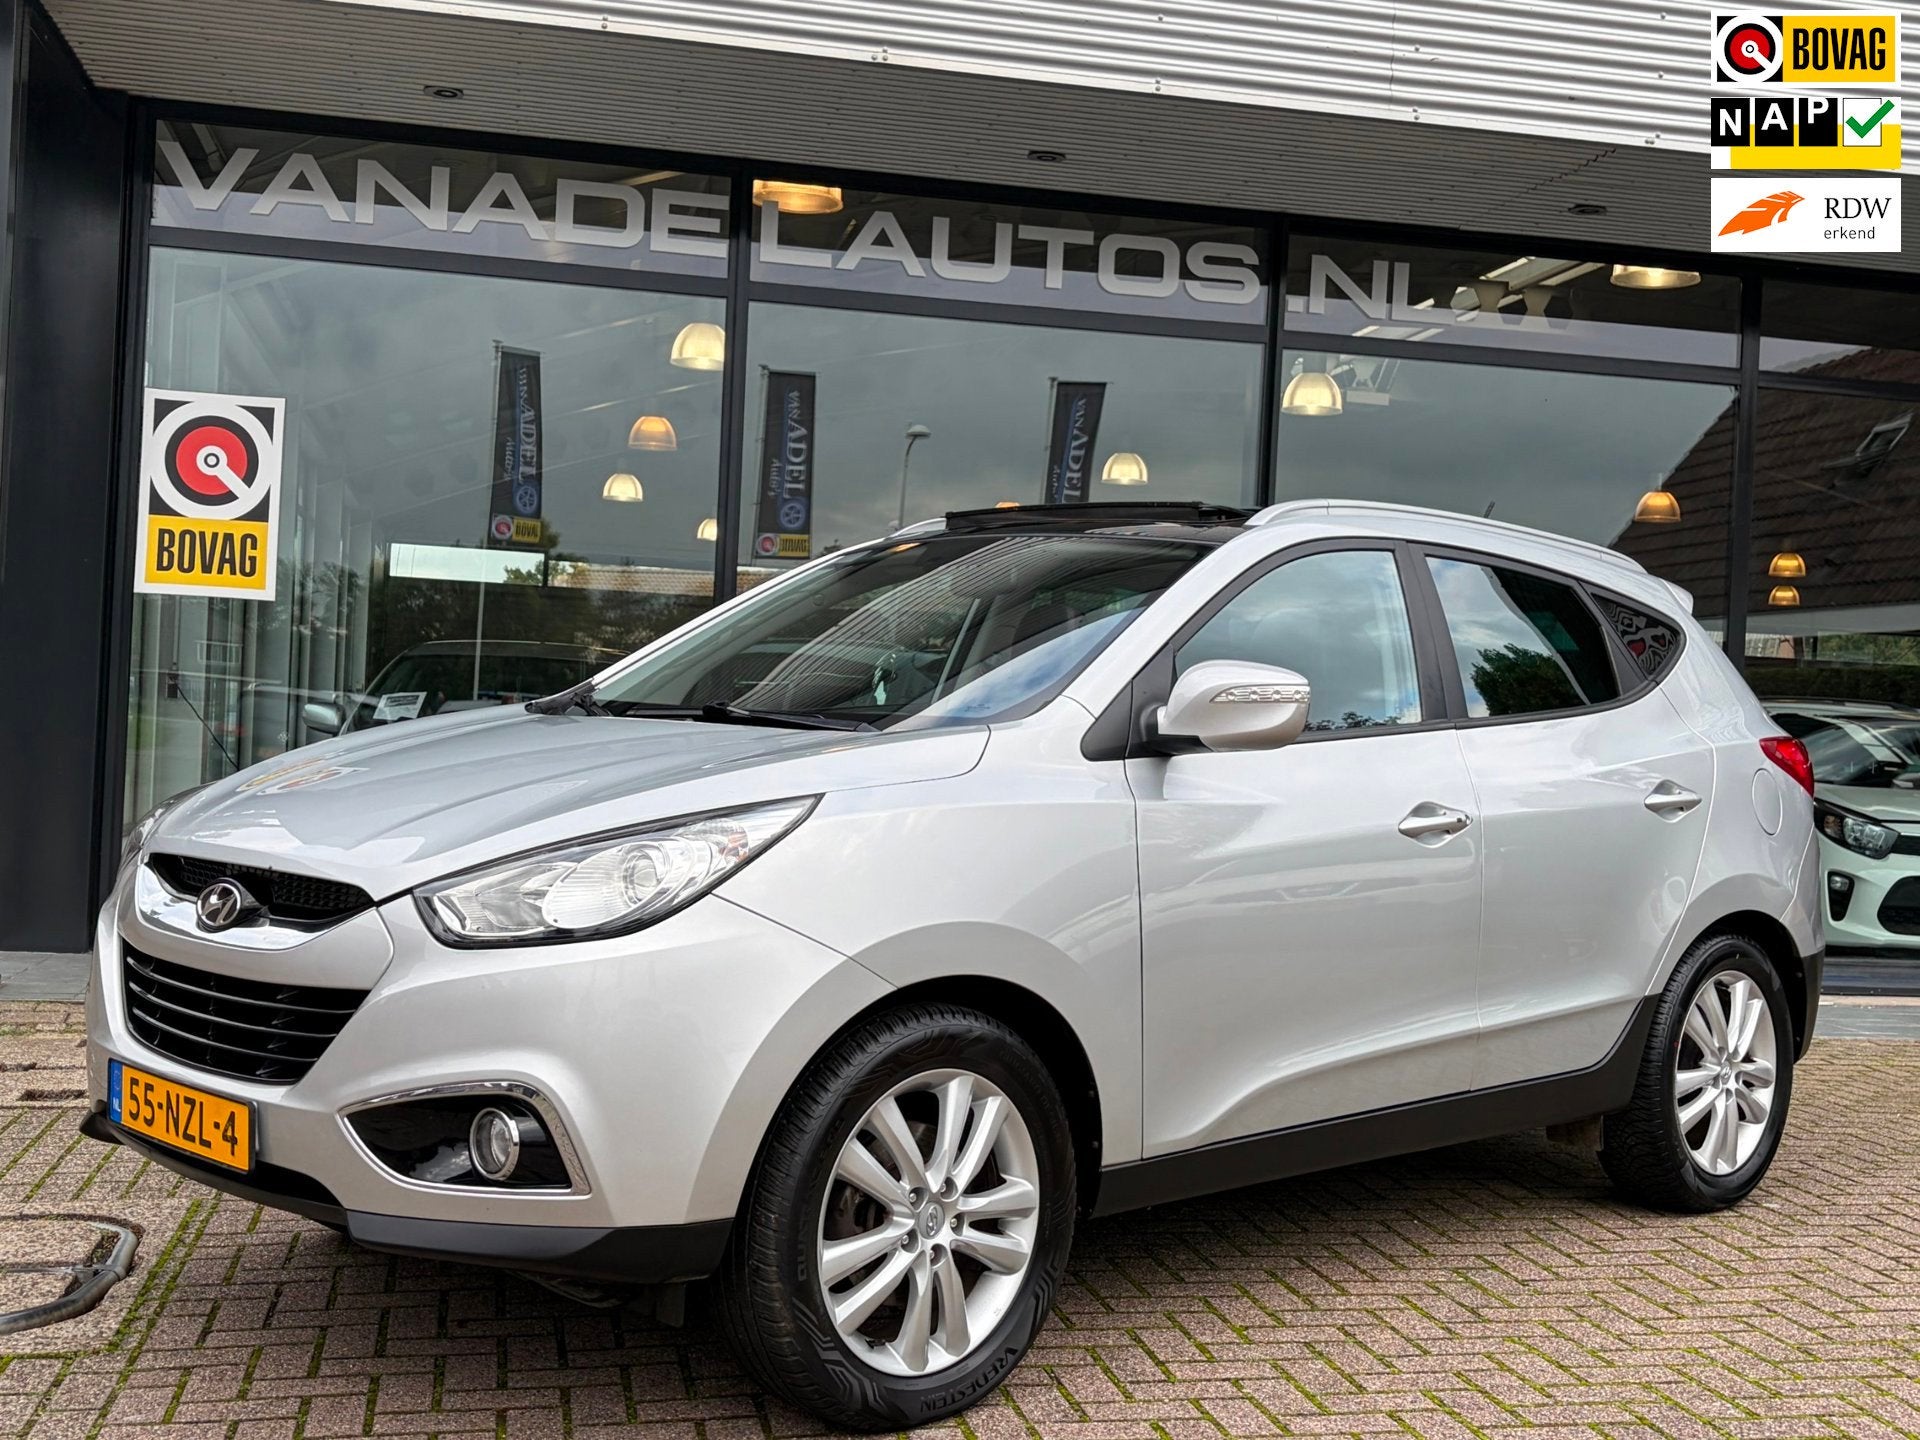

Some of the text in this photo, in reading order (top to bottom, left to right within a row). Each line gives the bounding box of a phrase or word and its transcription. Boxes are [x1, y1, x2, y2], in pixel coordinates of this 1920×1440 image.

[783, 419, 808, 499] ADEL
[156, 528, 258, 577] BOVAG
[113, 1097, 121, 1112] NL
[129, 1076, 238, 1157] 55-NZL-4
[920, 1347, 1018, 1413] VREDESTEIN
